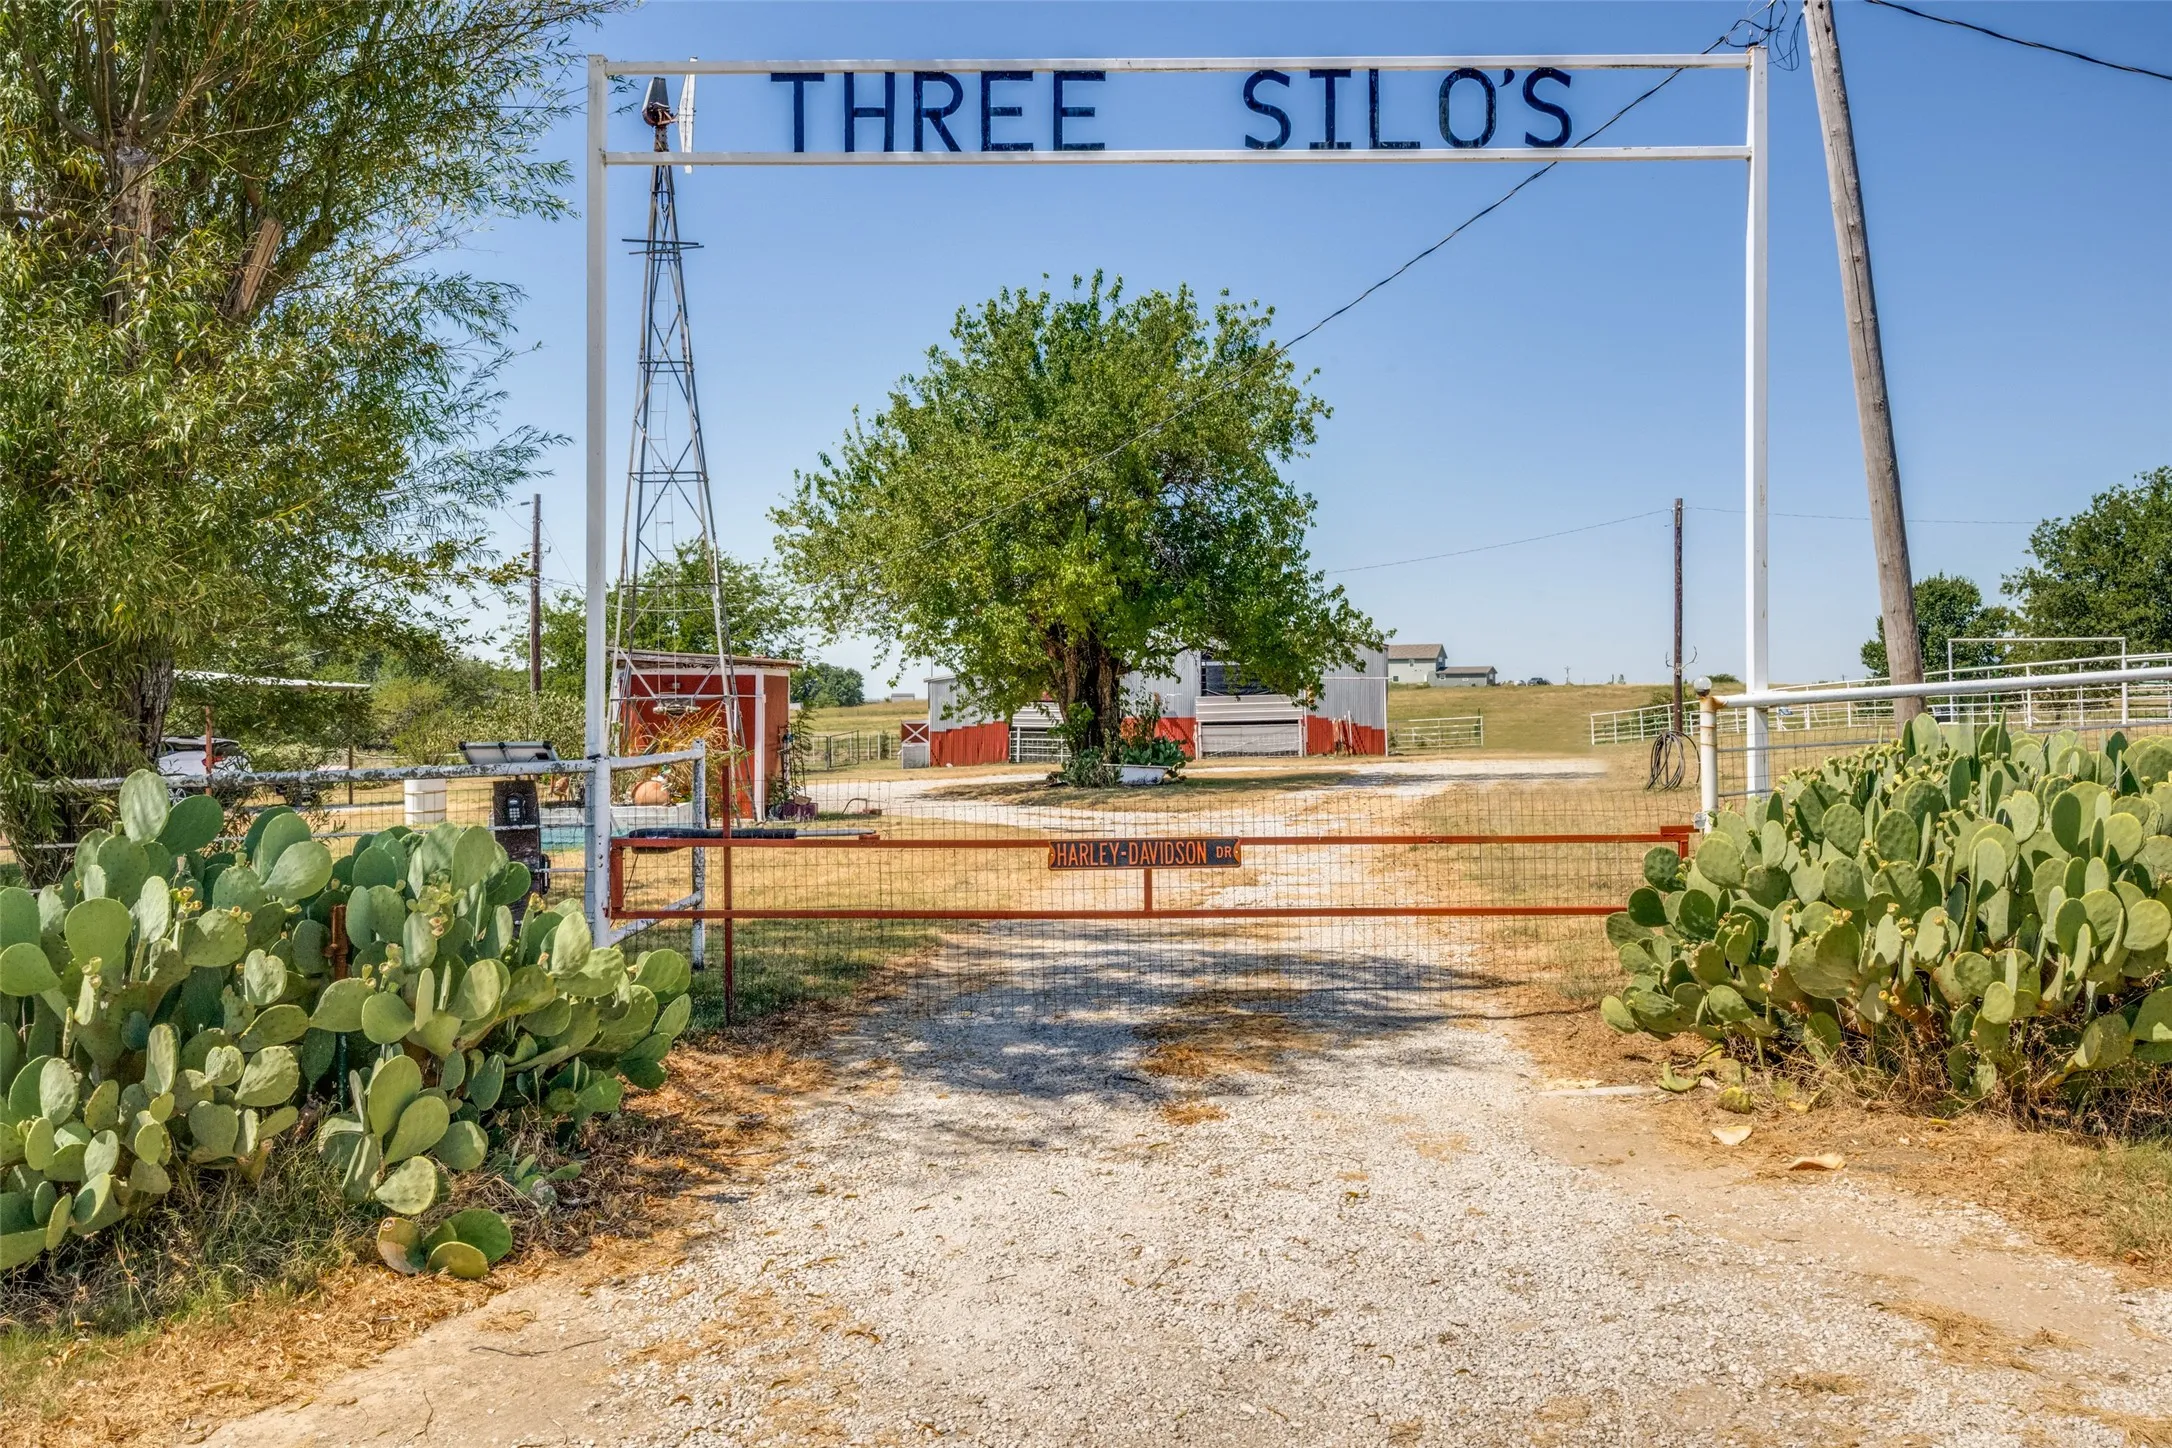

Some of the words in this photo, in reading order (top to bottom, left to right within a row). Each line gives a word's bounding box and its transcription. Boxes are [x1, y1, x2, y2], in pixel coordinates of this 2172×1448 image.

[771, 70, 1106, 153] THREE
[1243, 67, 1573, 150] SILO'S
[1057, 841, 1208, 866] HARLEY-DAVIDSON
[1216, 845, 1232, 859] DR
